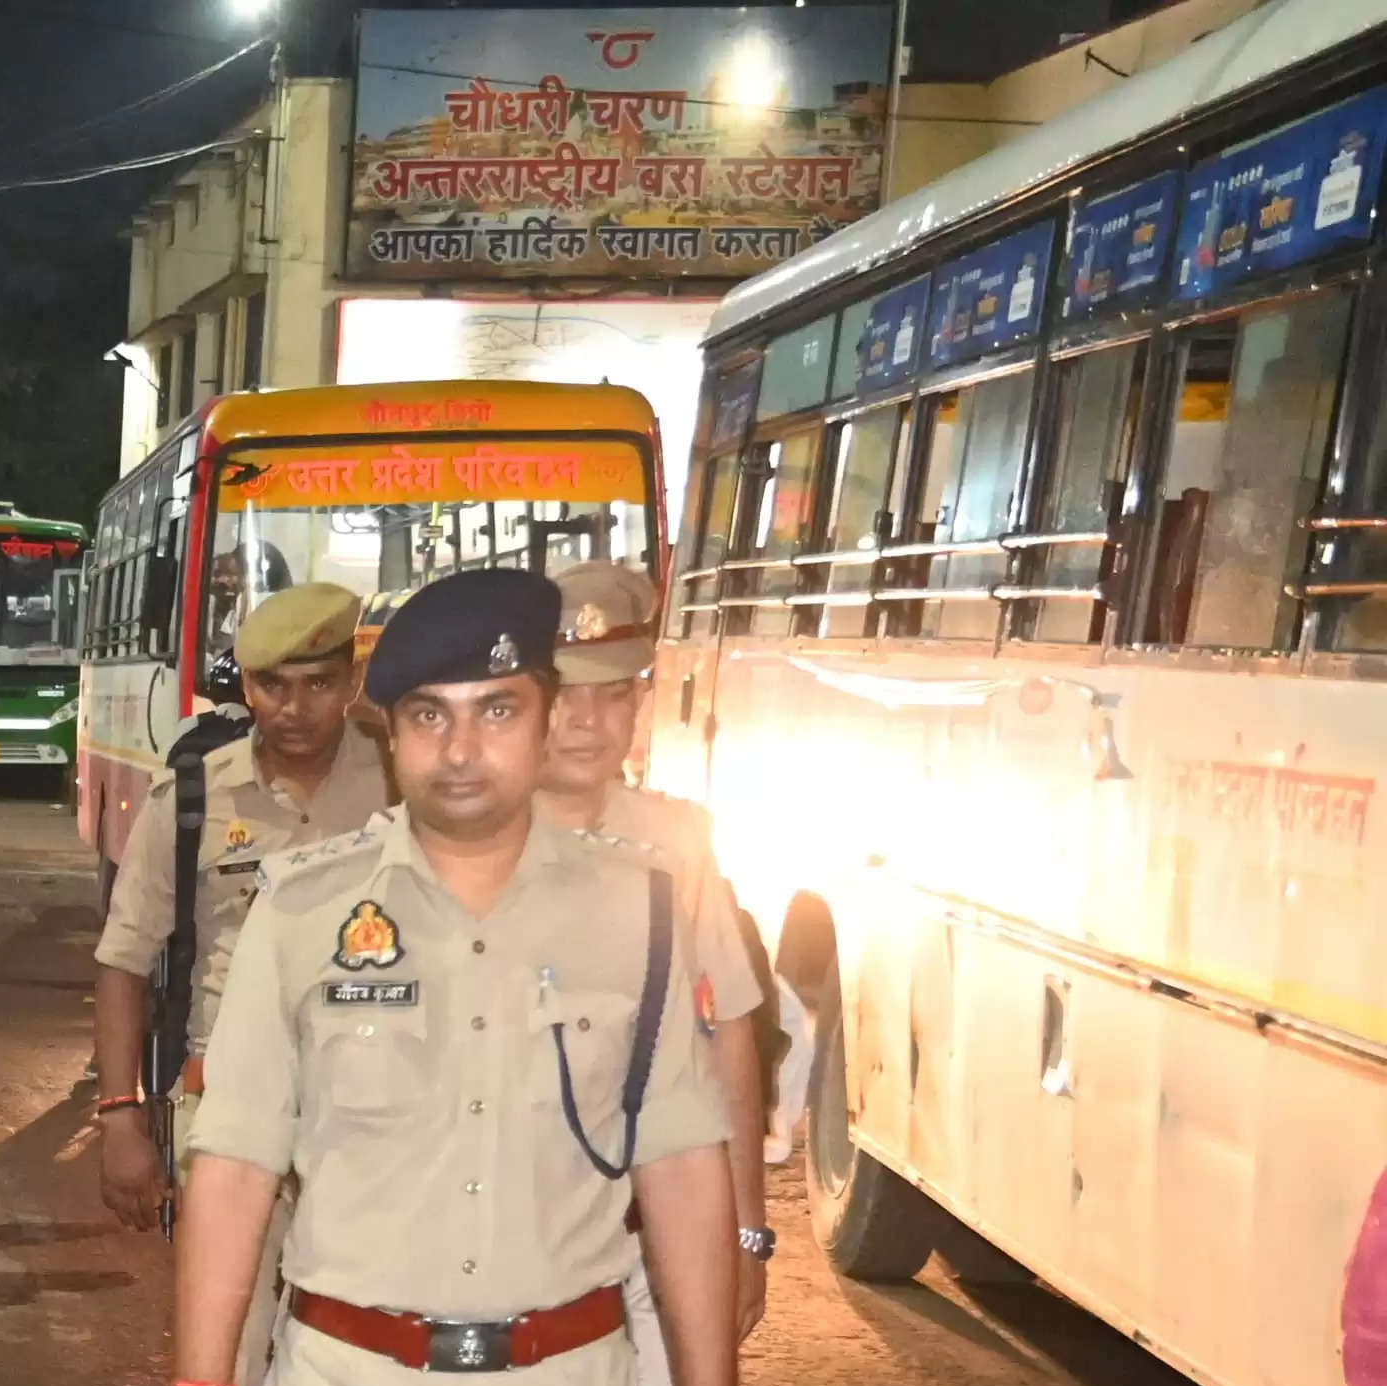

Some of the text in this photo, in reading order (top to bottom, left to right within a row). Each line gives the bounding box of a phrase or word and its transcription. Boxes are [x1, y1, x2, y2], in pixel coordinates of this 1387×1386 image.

[444, 74, 572, 134] चौधरी
[584, 90, 688, 133] चरण
[633, 157, 707, 200] बस
[720, 142, 856, 199] स्टेशन
[371, 224, 474, 262] आपका
[486, 215, 587, 261] हार्दिक
[599, 222, 703, 260] स्वागत
[712, 226, 801, 261] करता
[287, 446, 583, 494] उत्तर प्रदेश परिवहन
